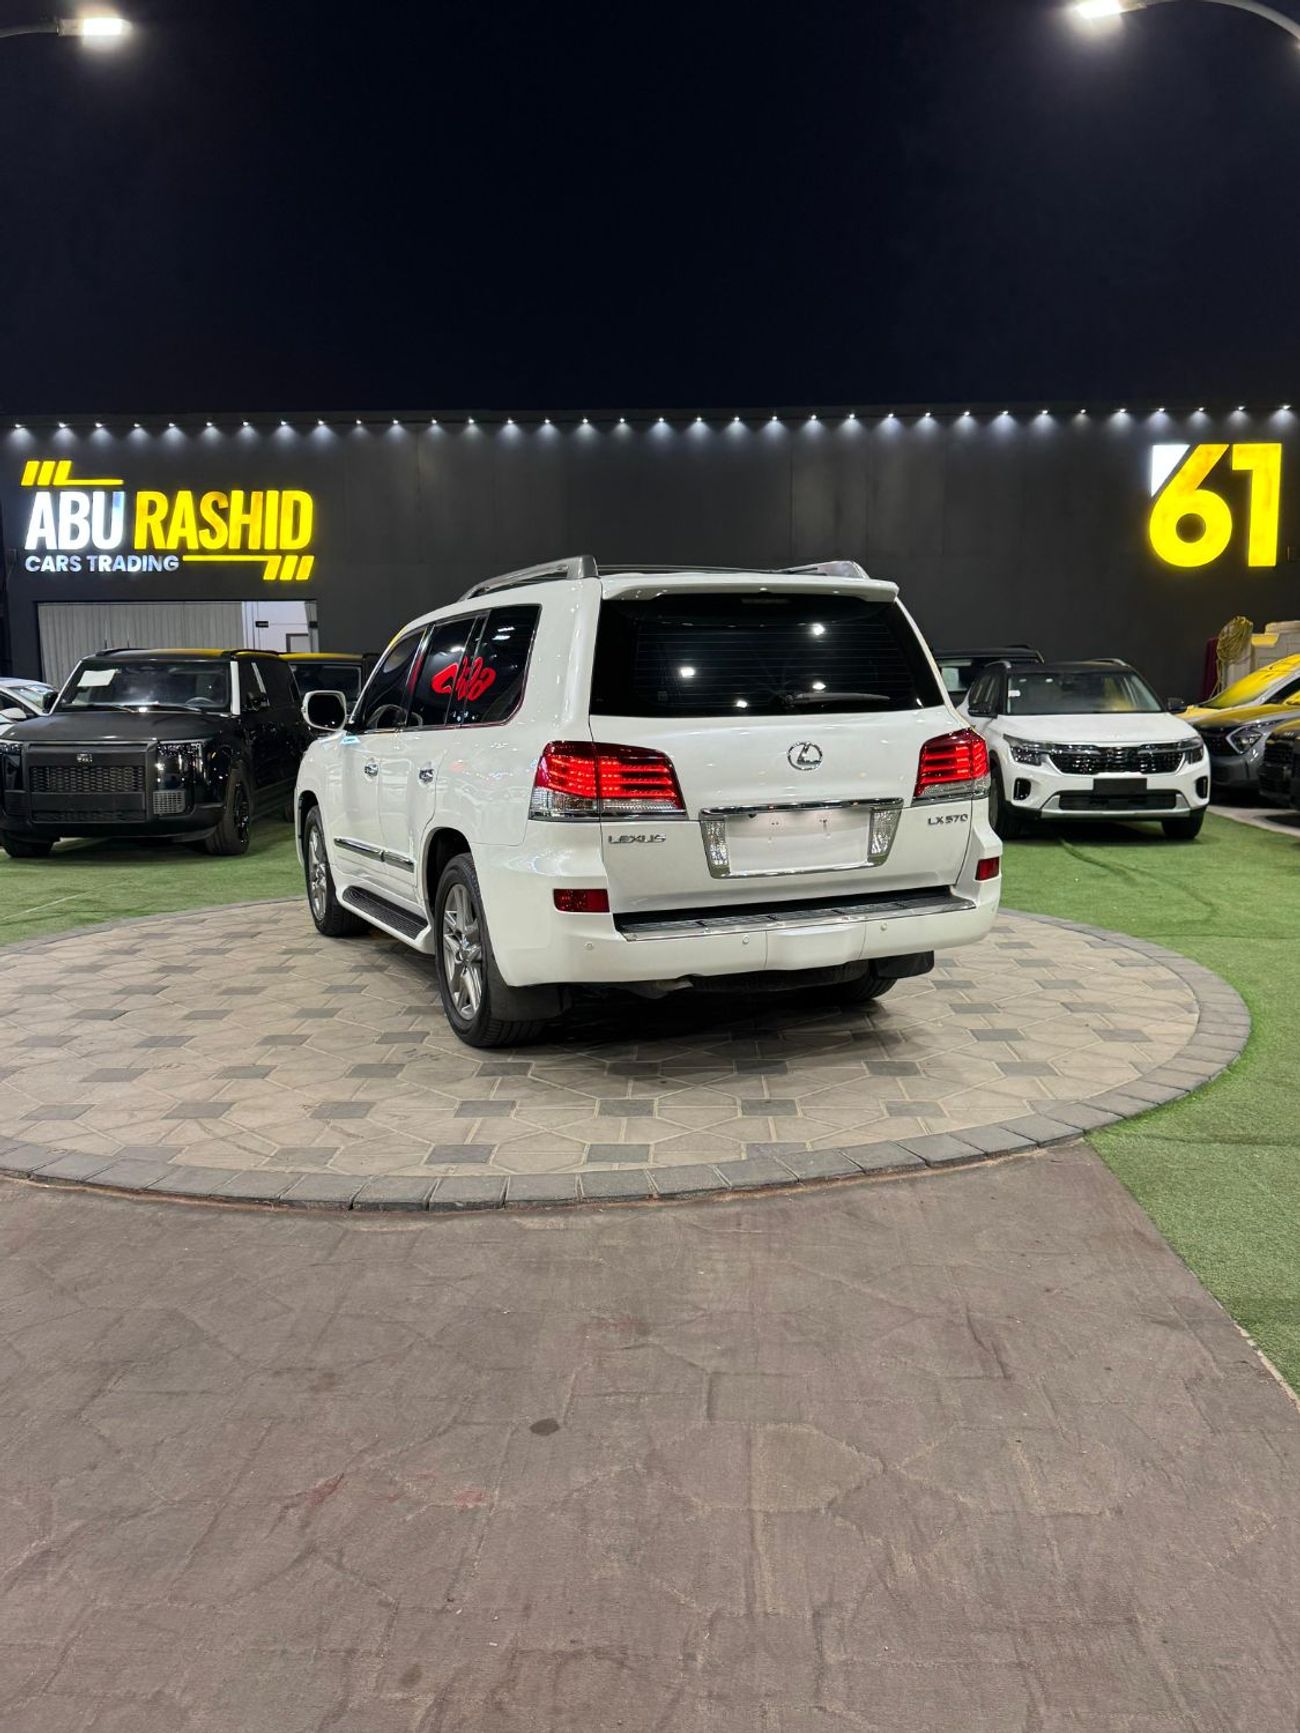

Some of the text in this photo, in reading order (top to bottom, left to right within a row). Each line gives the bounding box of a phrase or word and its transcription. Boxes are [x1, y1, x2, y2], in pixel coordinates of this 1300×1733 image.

[1149, 442, 1282, 567] 61
[24, 490, 314, 551] ABU RASHID
[25, 555, 179, 572] CARS TRADING
[928, 816, 944, 826] LX
[608, 834, 666, 844] LEXUS
